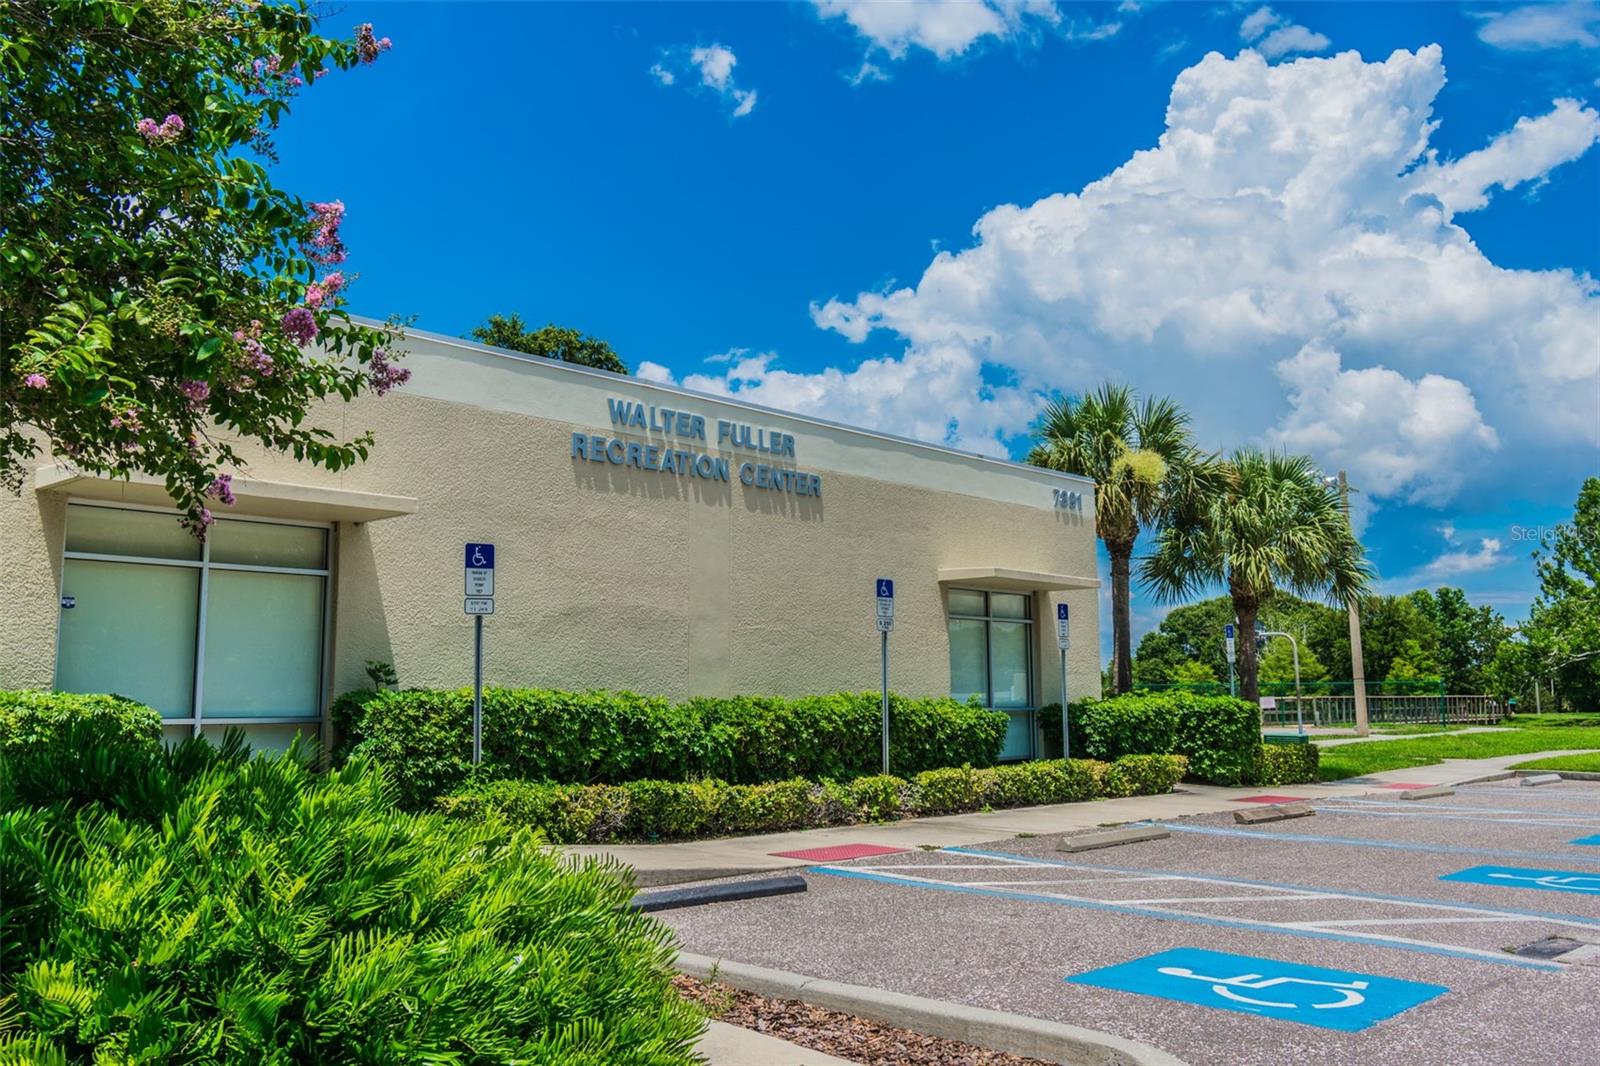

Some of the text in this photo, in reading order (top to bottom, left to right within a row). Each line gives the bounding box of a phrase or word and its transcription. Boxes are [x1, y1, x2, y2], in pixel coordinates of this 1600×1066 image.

[607, 398, 796, 457] WALTER FULLER
[571, 432, 822, 497] RECREATION CENTER
